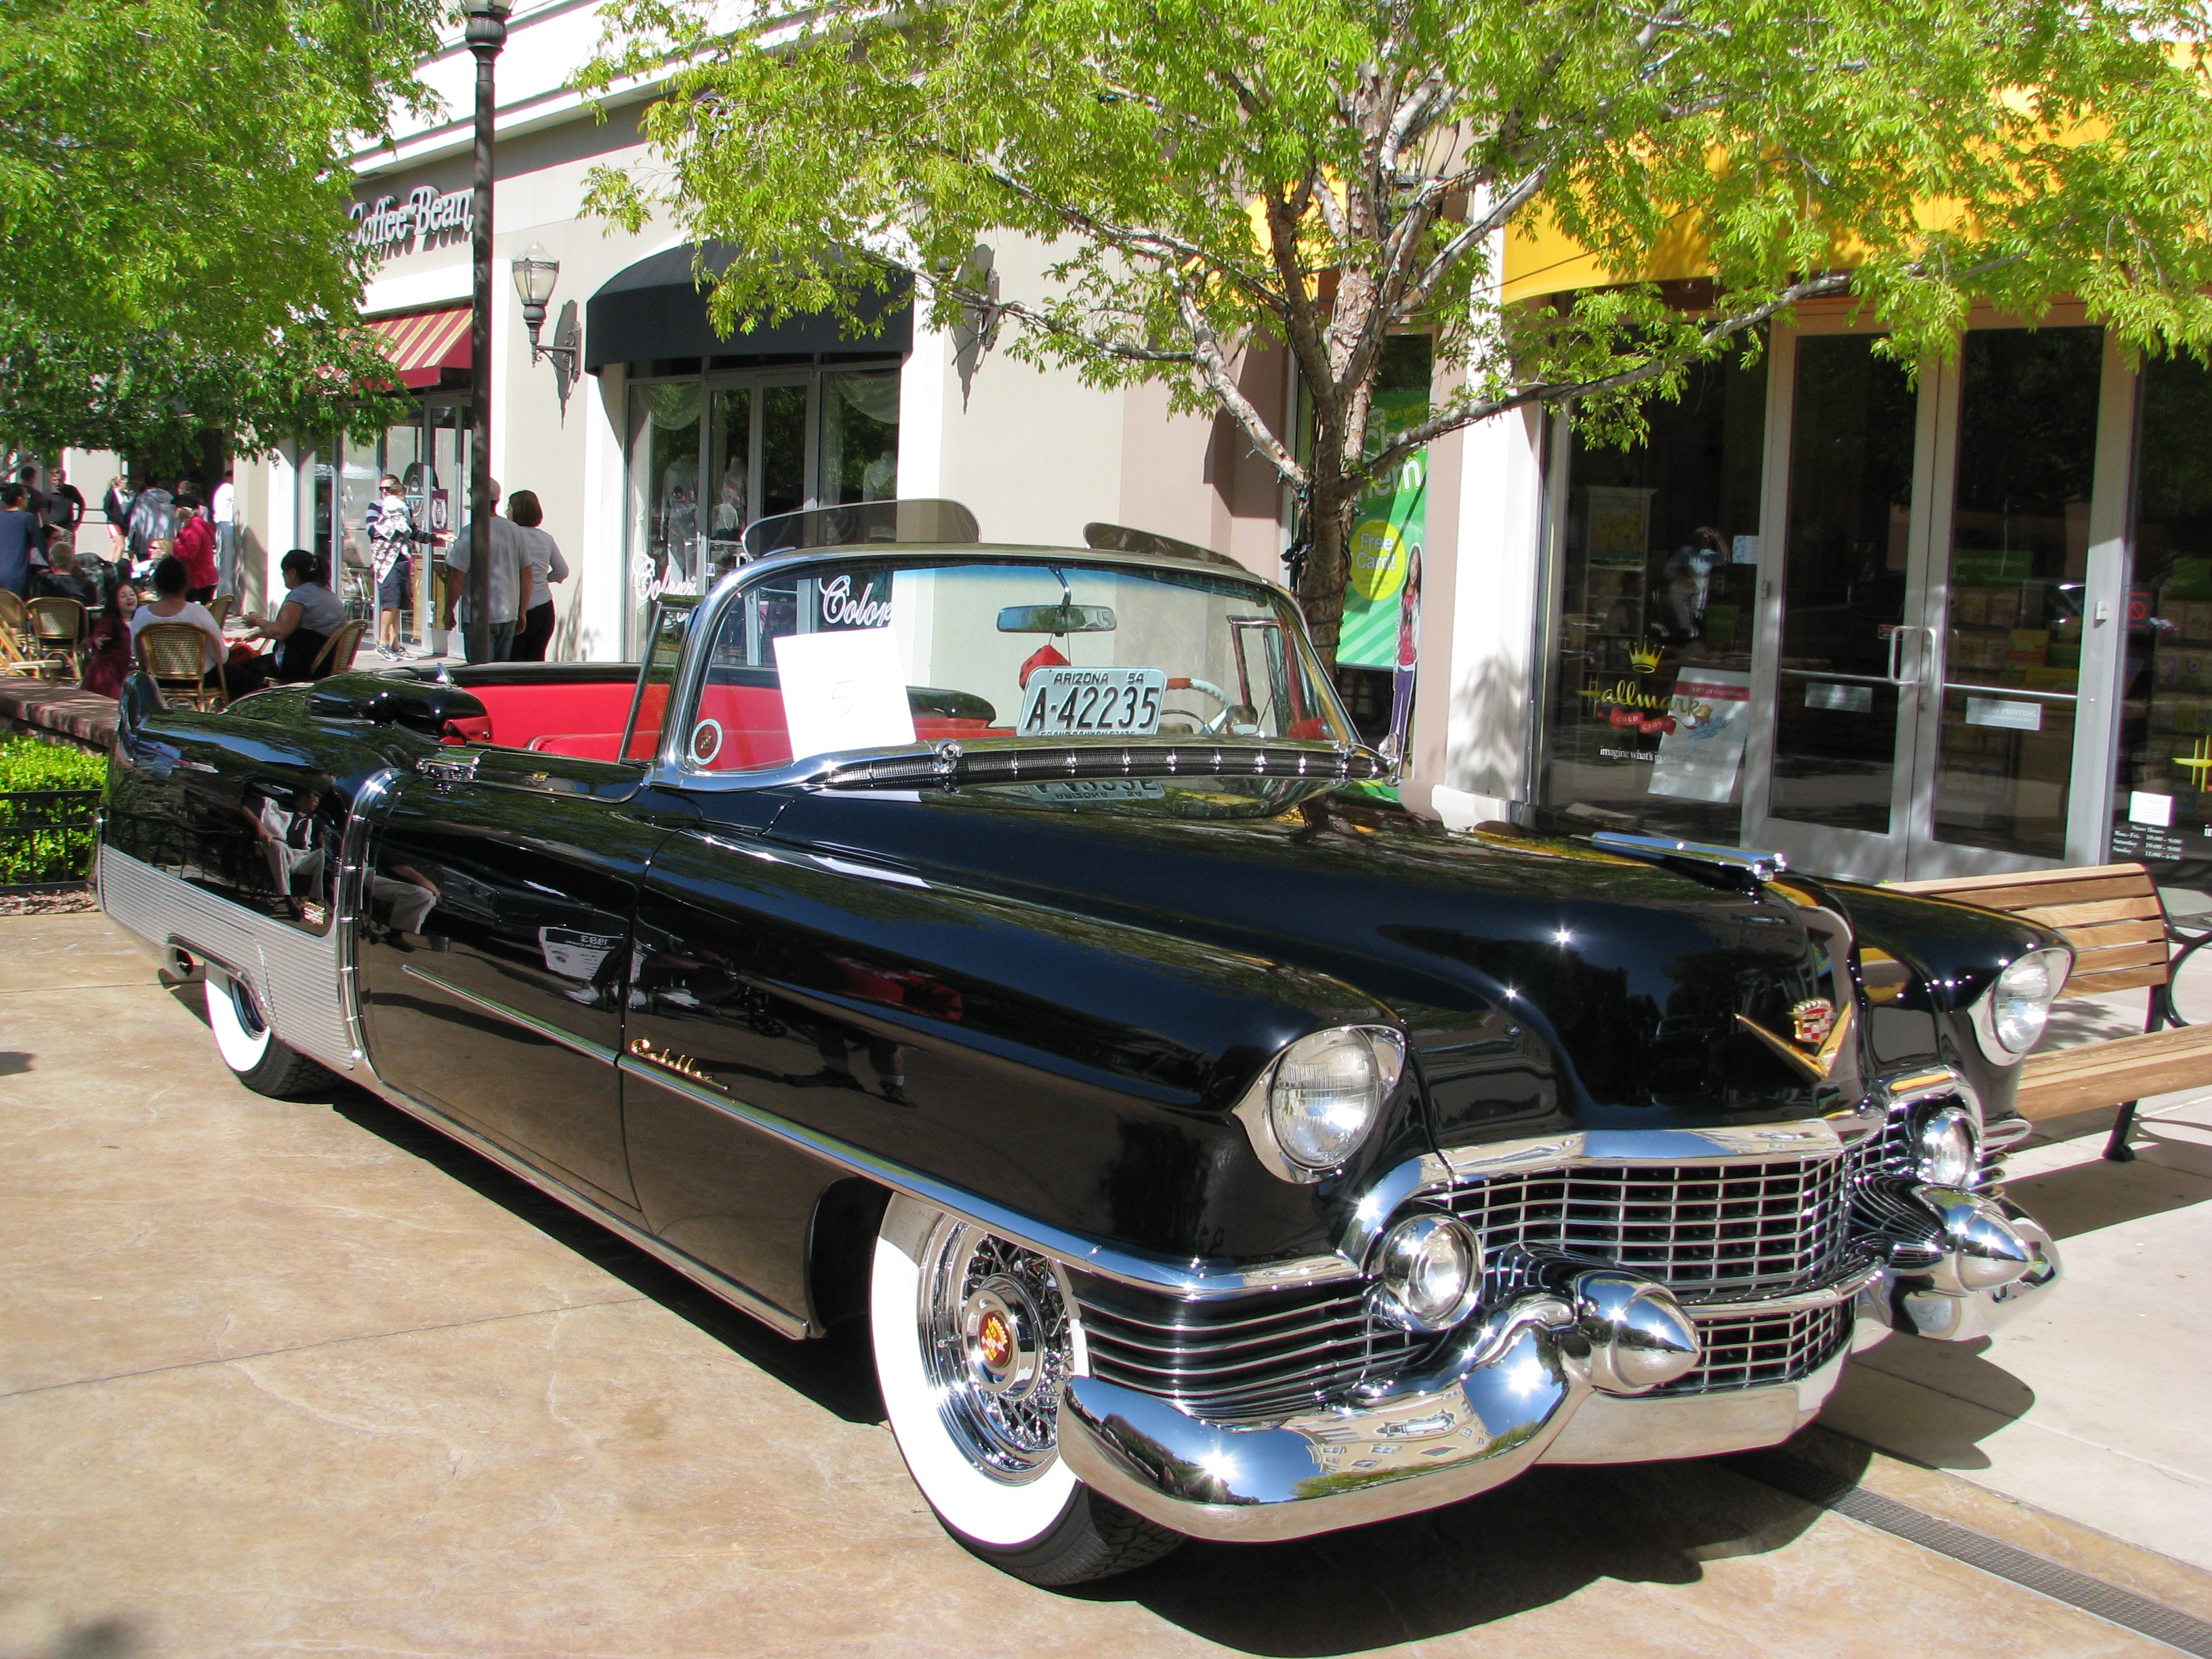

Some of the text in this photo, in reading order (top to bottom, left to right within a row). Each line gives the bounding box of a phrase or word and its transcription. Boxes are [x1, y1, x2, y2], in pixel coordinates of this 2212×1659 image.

[349, 185, 474, 247] Coffee Bean
[1368, 411, 1385, 424] EW!
[1360, 532, 1393, 552] Free
[1356, 550, 1396, 571] Card!
[1053, 672, 1145, 684] ARIZONA 54
[1024, 685, 1160, 731] A-42235
[2001, 708, 2037, 718] PRINTING
[1642, 720, 1670, 731] CROWN
[1599, 746, 1629, 759] imagine
[1630, 749, 1654, 761] what's
